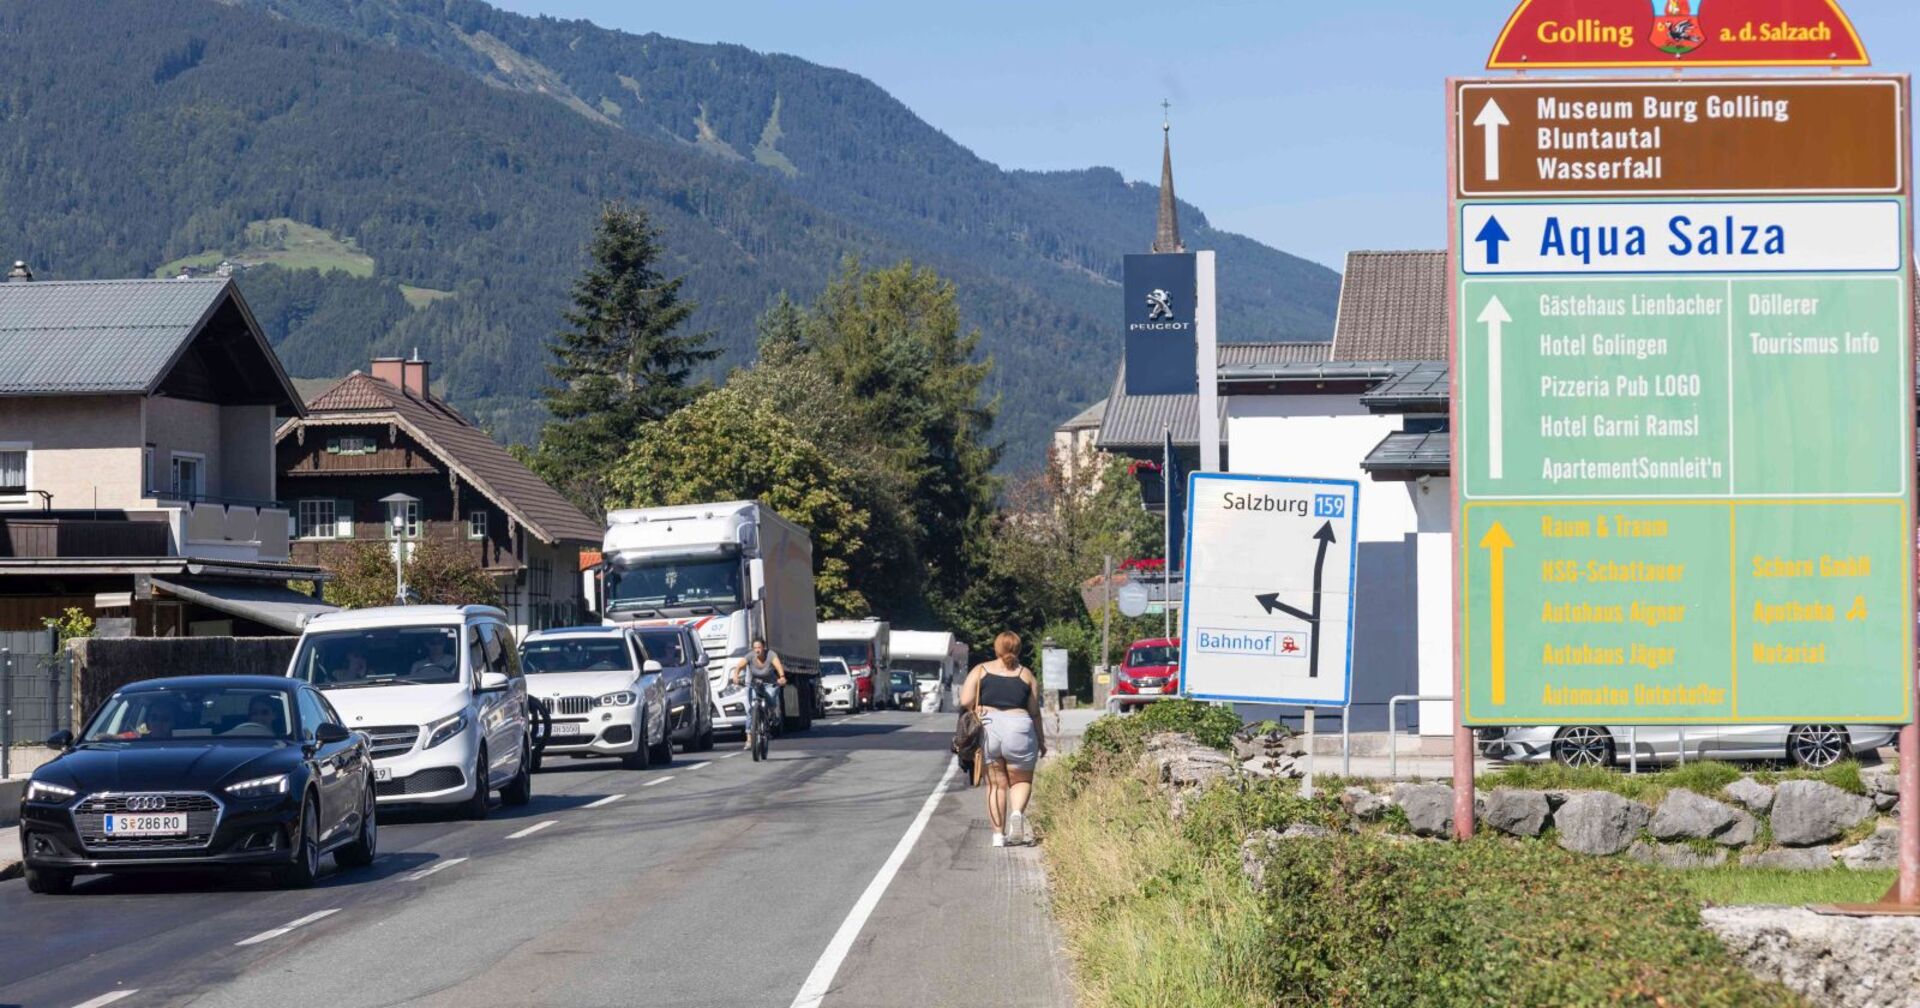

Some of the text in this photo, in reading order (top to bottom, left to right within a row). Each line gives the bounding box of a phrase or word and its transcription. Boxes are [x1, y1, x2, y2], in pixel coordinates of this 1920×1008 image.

[1537, 19, 1634, 48] Golling
[1759, 21, 1831, 42] Salzach
[1537, 95, 1789, 124] Museum Burg Golling
[1537, 126, 1661, 149] Bluntautal
[1537, 157, 1662, 179] Wasserfall
[1540, 216, 1785, 264] Aqua Salza
[1539, 294, 1722, 316] Gästehaus Lienbacher
[1749, 294, 1819, 315] Döllerer
[1130, 322, 1189, 330] PEUGEOT
[1540, 333, 1668, 359] Hotel Golingen
[1751, 333, 1879, 354] Tourismus Info
[1541, 374, 1700, 397] Pizzeria Pub LOGO
[1541, 414, 1699, 437] Hotel Garni Ramsl
[1223, 492, 1344, 517] Salzburg 159
[1541, 514, 1590, 537] Raum
[1542, 600, 1623, 624] Autohaus
[1199, 632, 1272, 651] Bahnhof
[1753, 640, 1825, 663] Notariat
[1543, 642, 1675, 669] Autohaus Jäger
